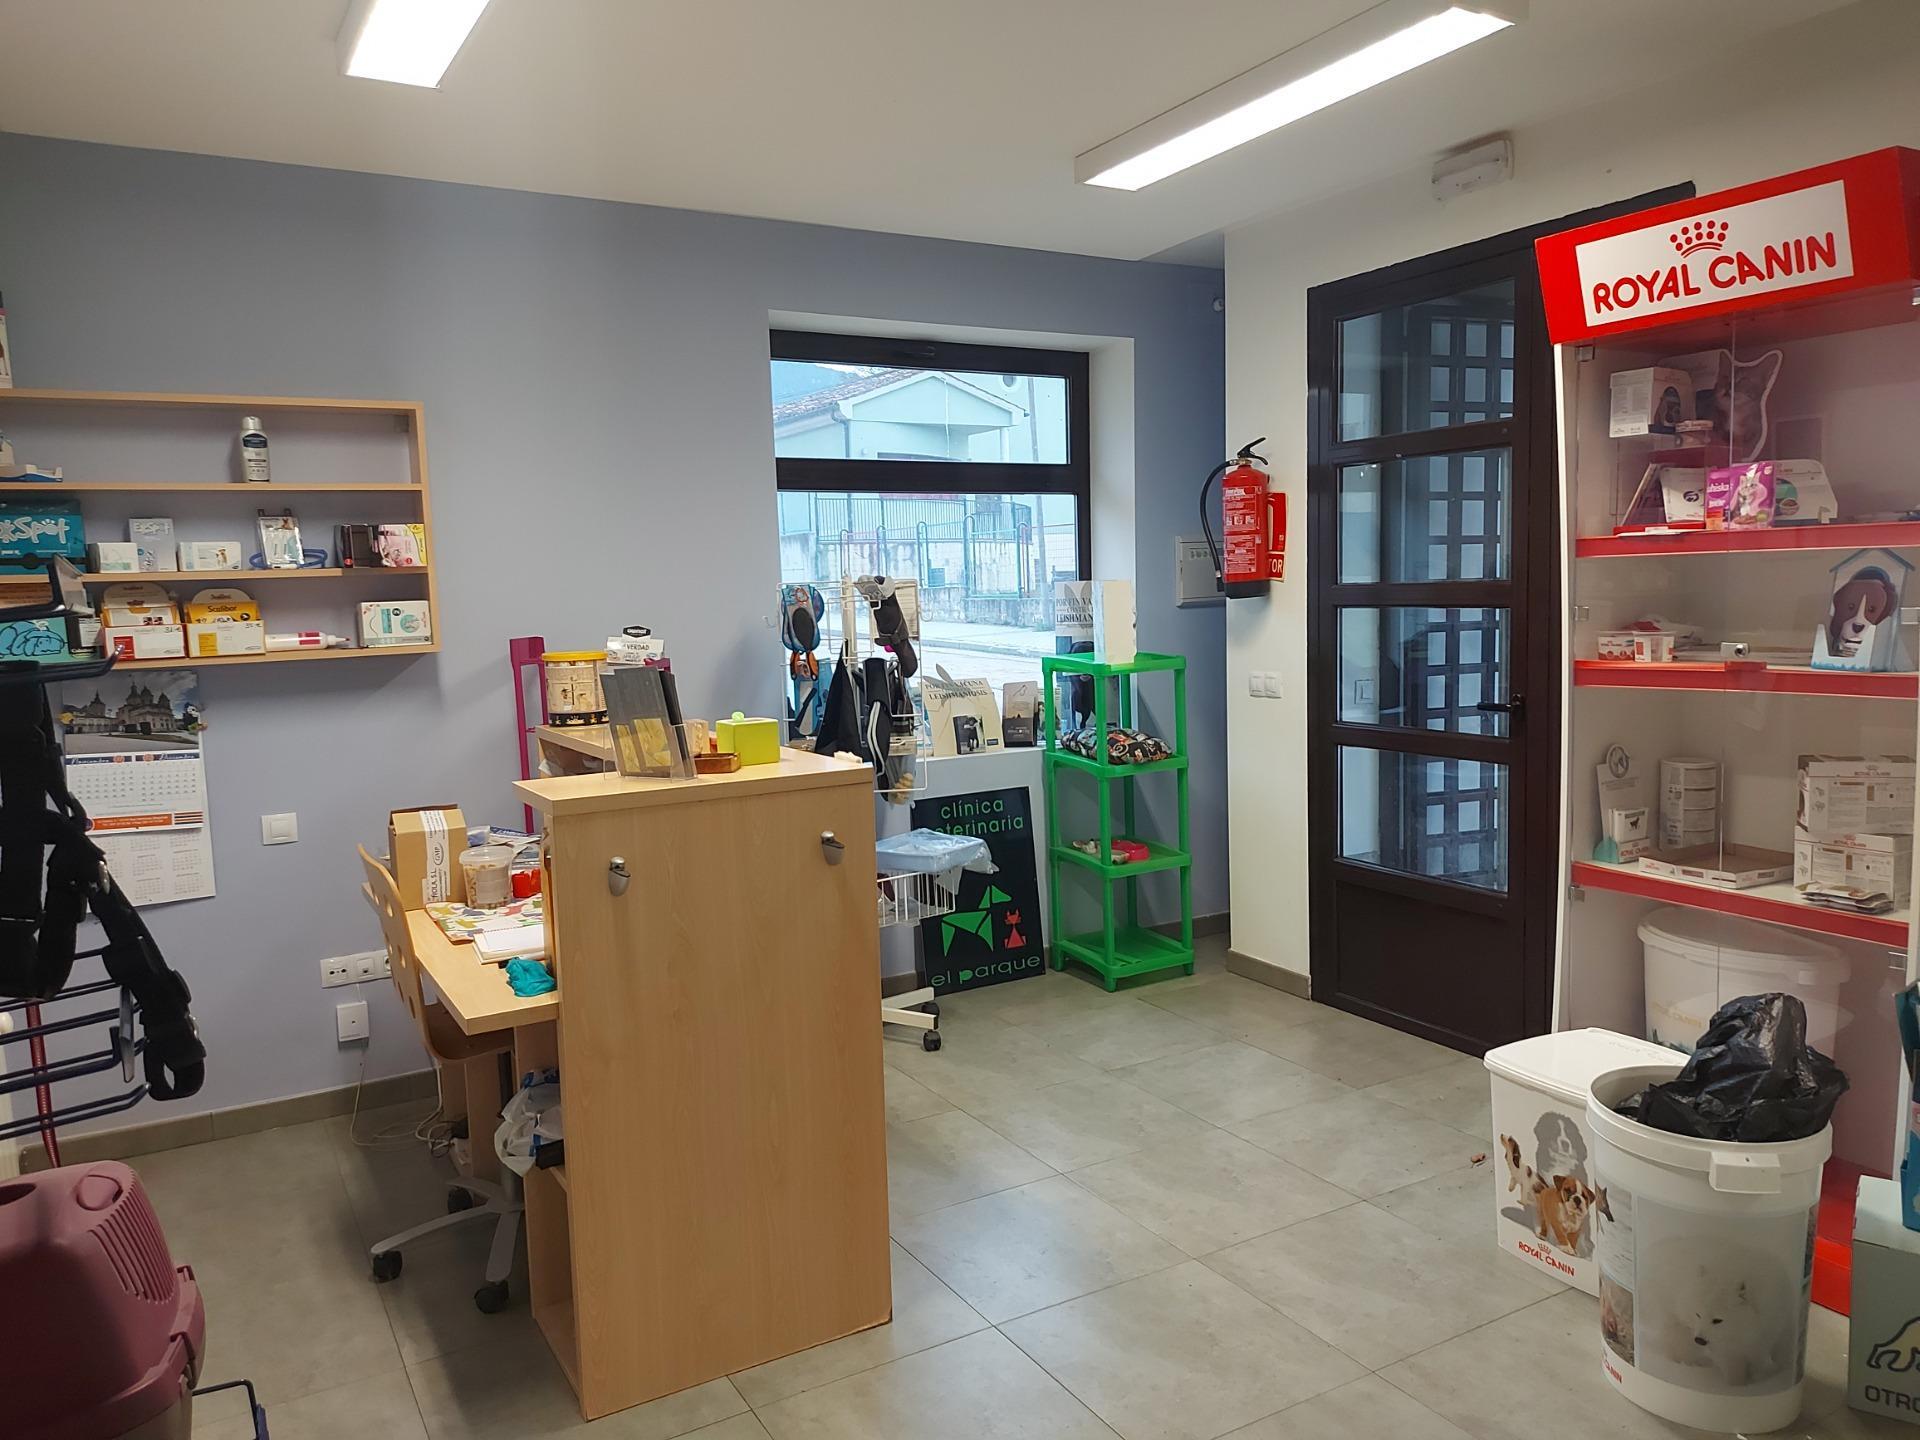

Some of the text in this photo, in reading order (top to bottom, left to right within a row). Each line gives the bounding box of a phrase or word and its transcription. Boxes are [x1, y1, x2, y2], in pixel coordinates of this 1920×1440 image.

[1593, 231, 1837, 314] ROYAL CANIN
[207, 604, 238, 613] Scalibor
[941, 799, 1004, 819] clínica
[931, 955, 1041, 987] el parque
[1518, 1241, 1575, 1277] ROYAL CANIN
